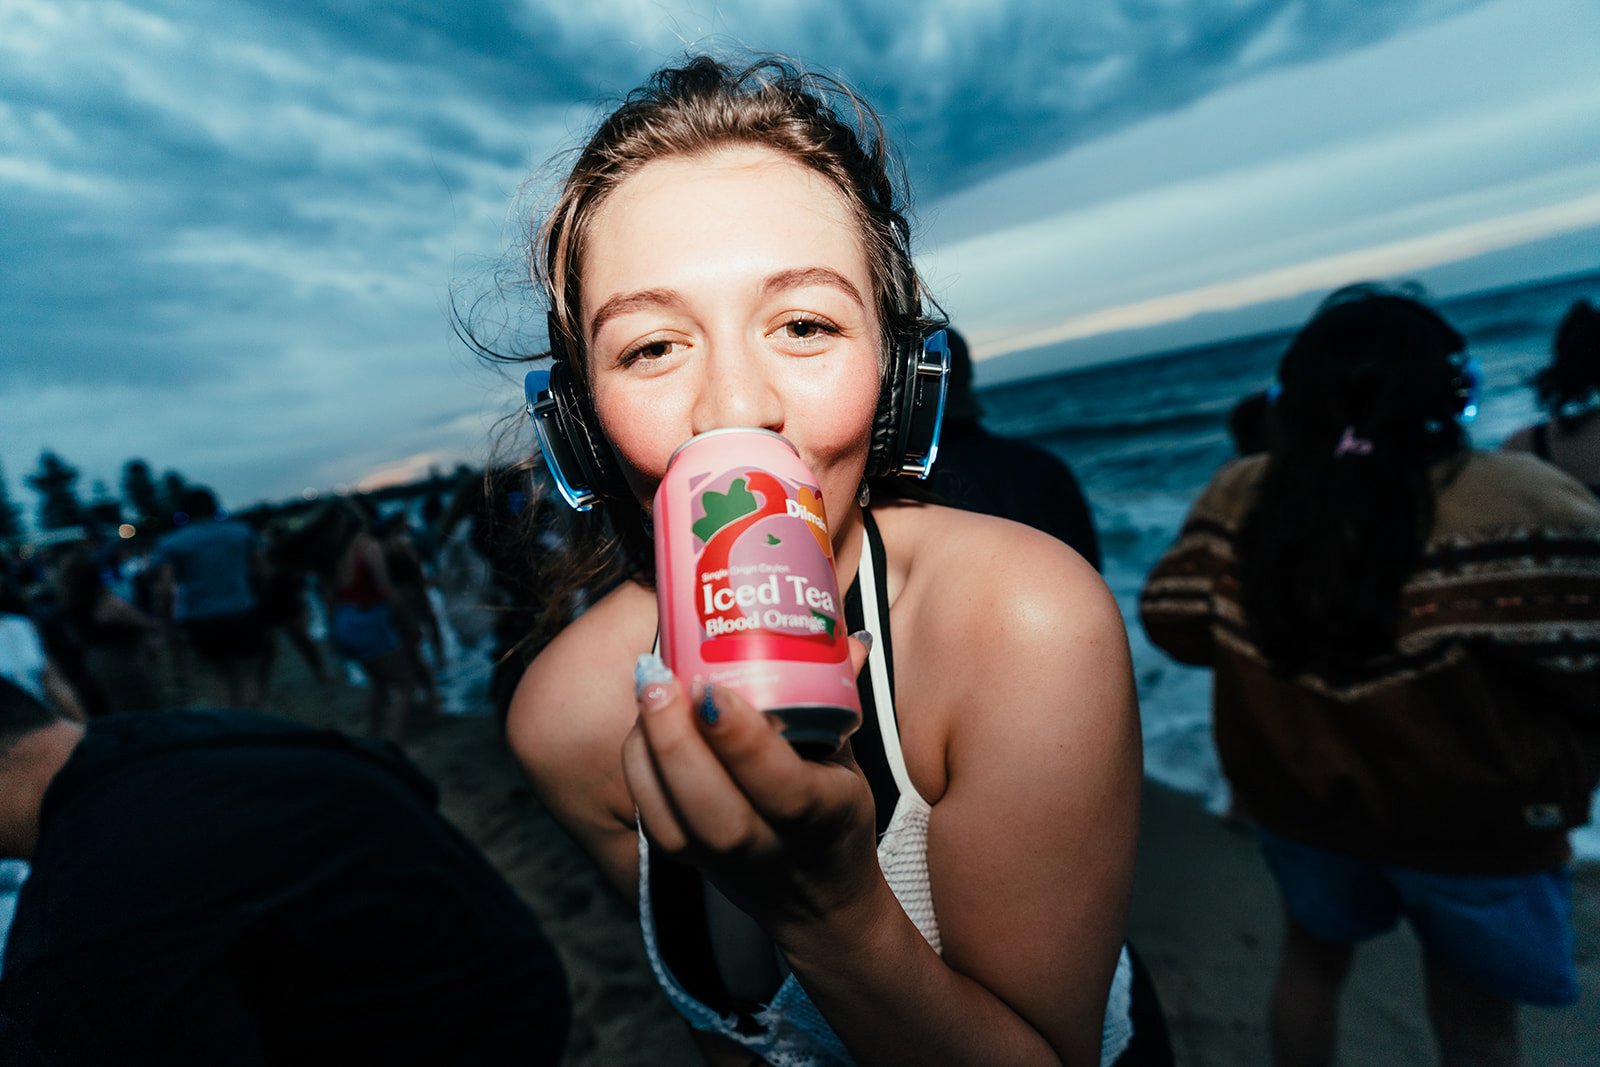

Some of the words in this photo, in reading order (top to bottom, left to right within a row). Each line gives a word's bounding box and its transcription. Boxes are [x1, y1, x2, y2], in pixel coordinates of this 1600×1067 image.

[701, 567, 728, 583] Single
[702, 574, 779, 615] Iced
[785, 575, 835, 613] Tea
[705, 610, 760, 638] Blood
[763, 609, 827, 633] Orange
